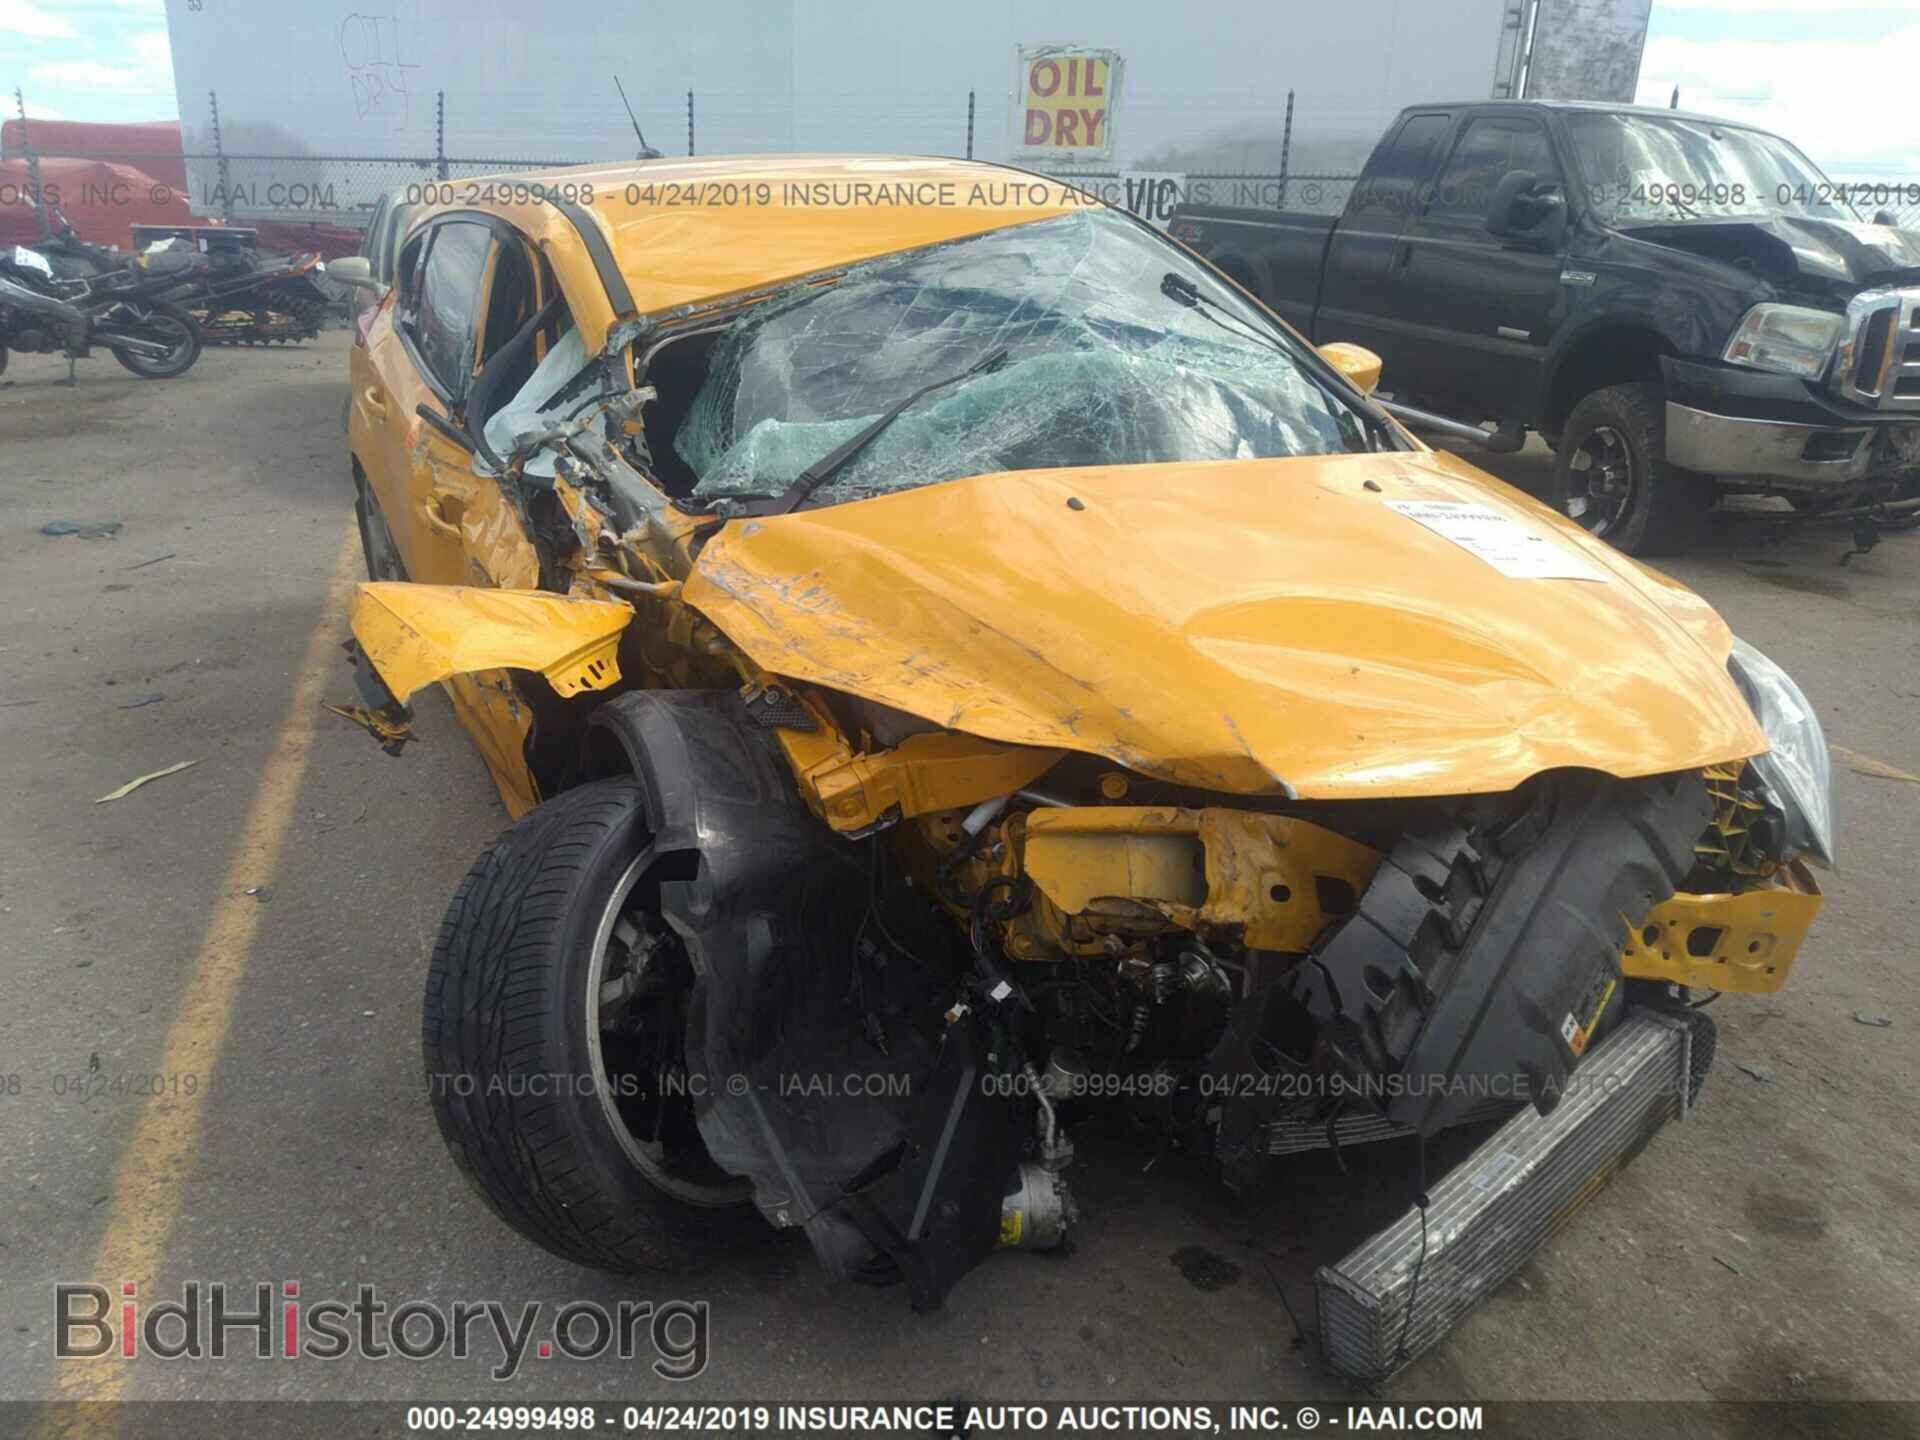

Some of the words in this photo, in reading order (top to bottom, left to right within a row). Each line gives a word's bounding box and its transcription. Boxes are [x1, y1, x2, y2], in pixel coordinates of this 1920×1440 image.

[1029, 58, 1104, 97] OIL
[1024, 108, 1104, 146] DRY
[1126, 178, 1176, 221] VIC
